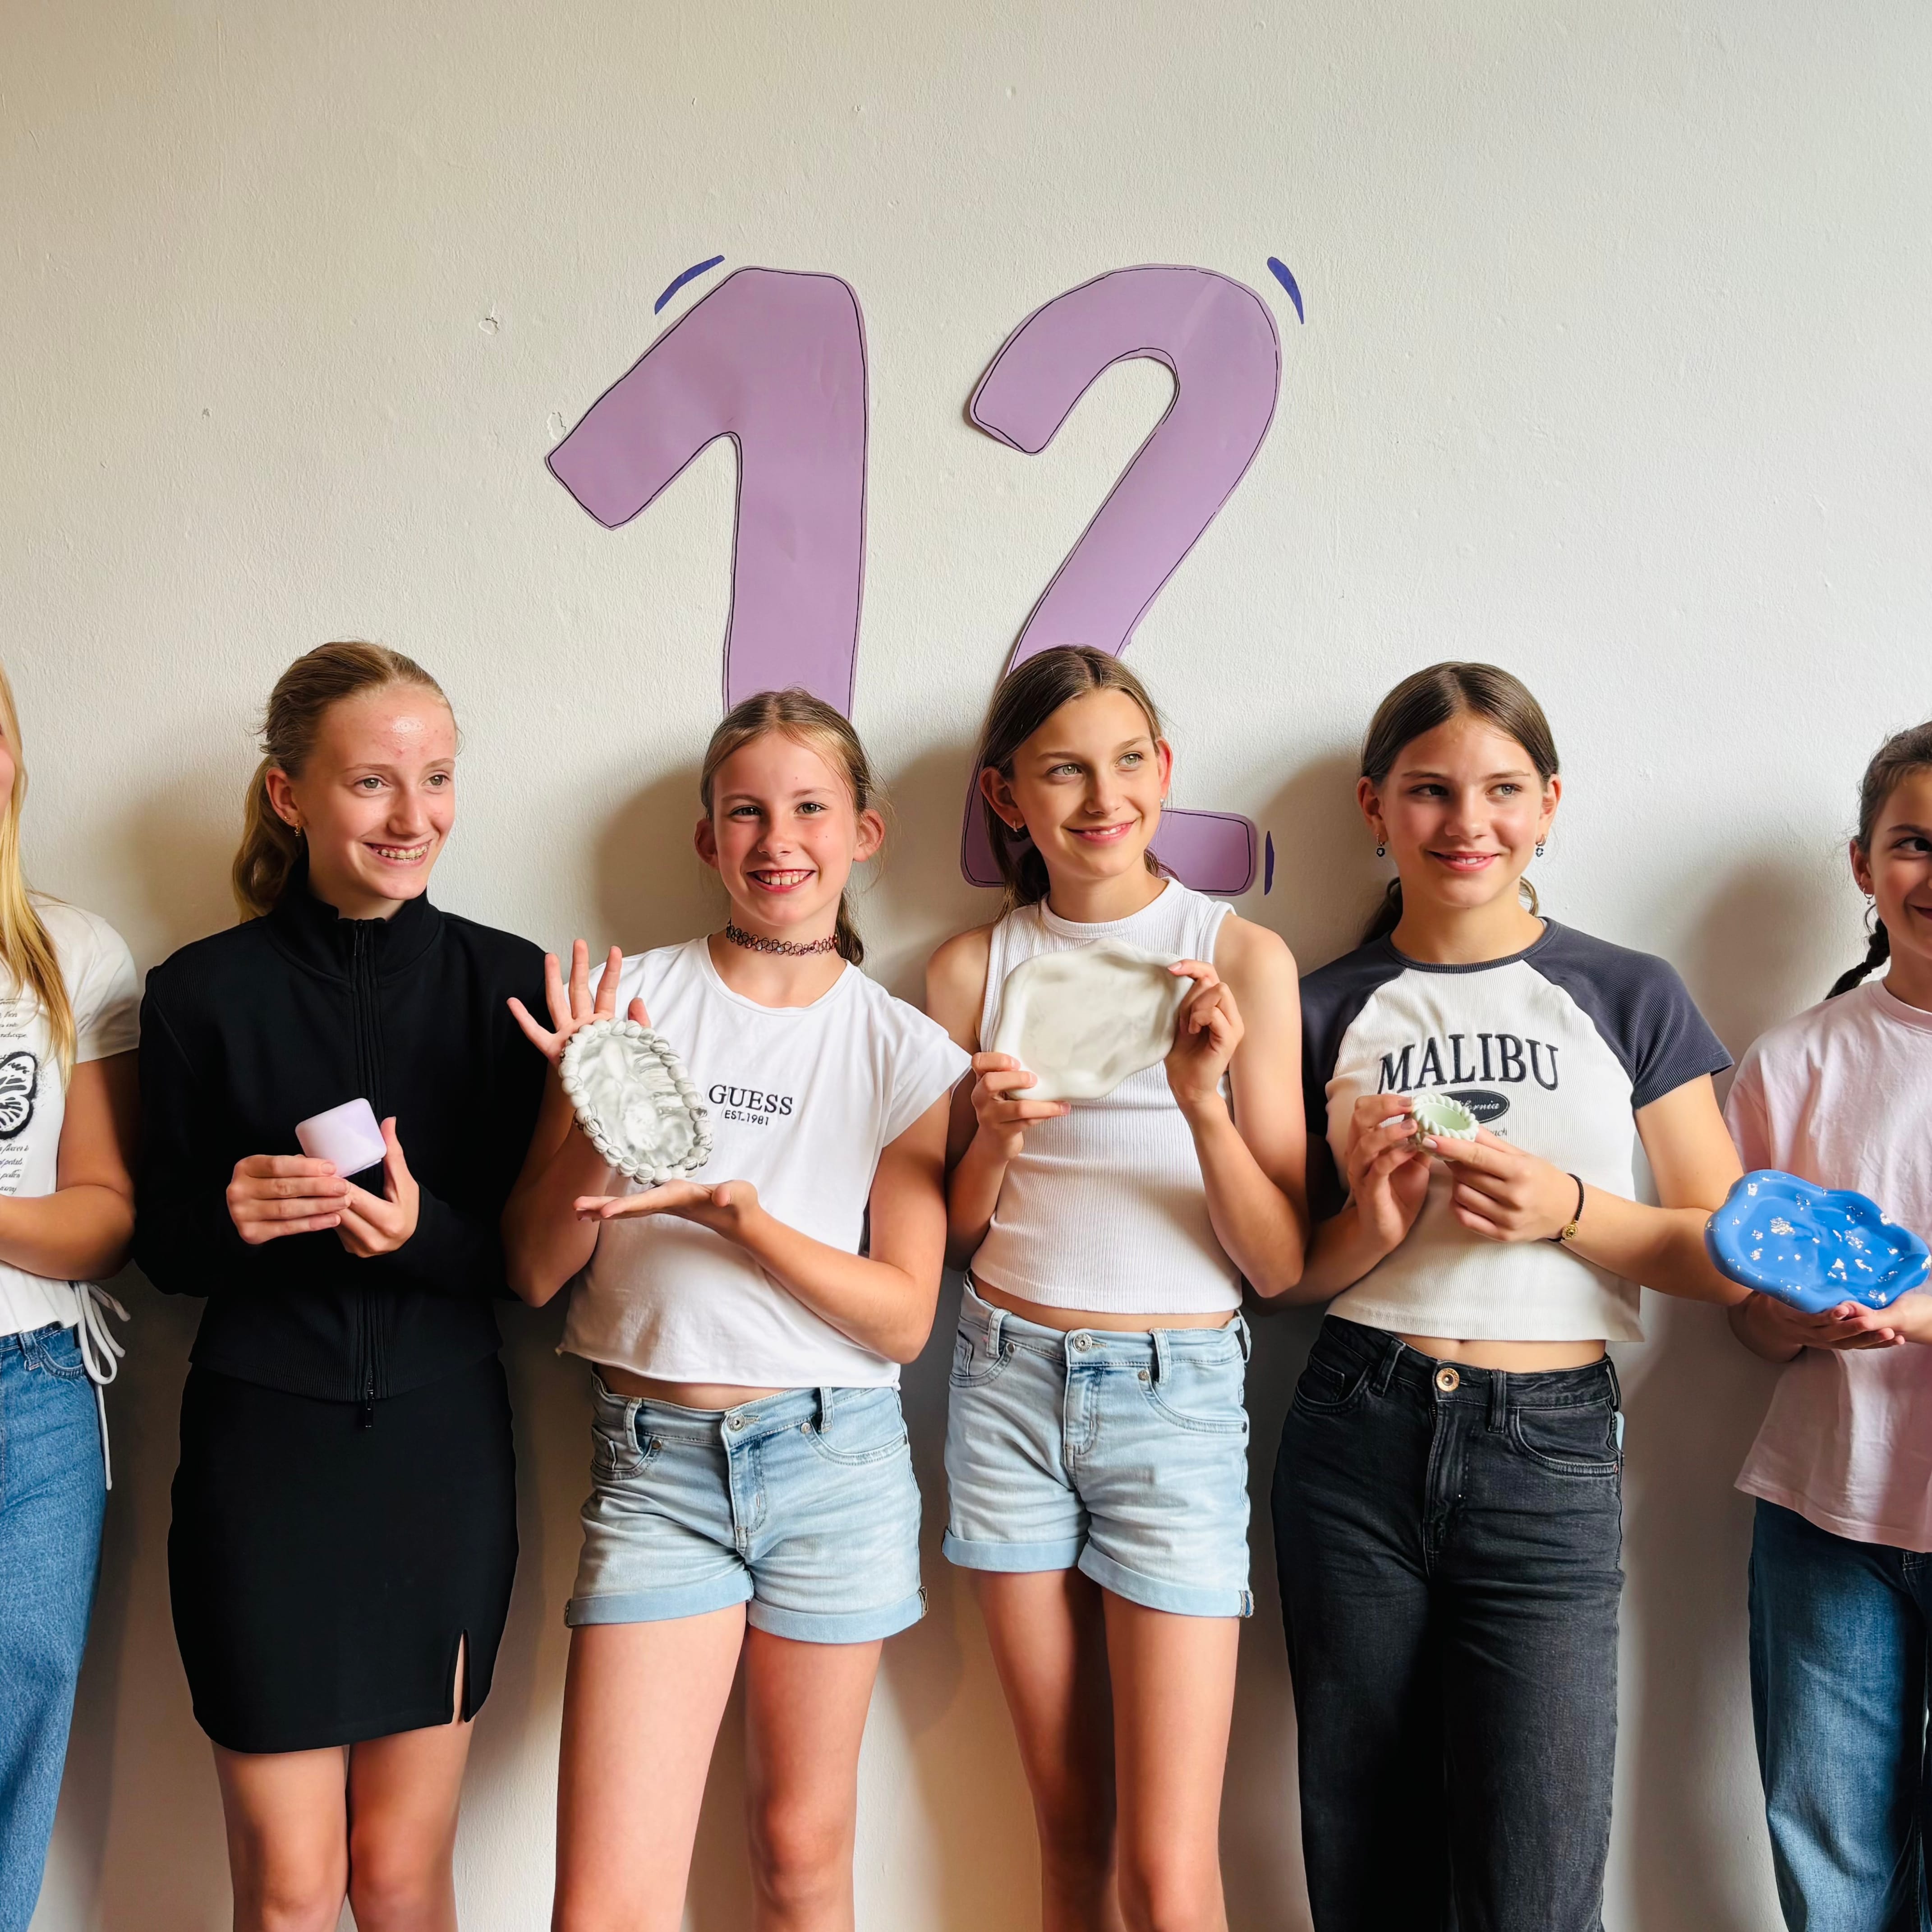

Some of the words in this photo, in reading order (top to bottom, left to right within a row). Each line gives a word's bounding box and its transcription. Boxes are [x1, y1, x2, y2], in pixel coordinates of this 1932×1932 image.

[546, 265, 1283, 897] 12
[1377, 1033, 1559, 1095] MALIBU
[708, 1084, 793, 1116] GUESS
